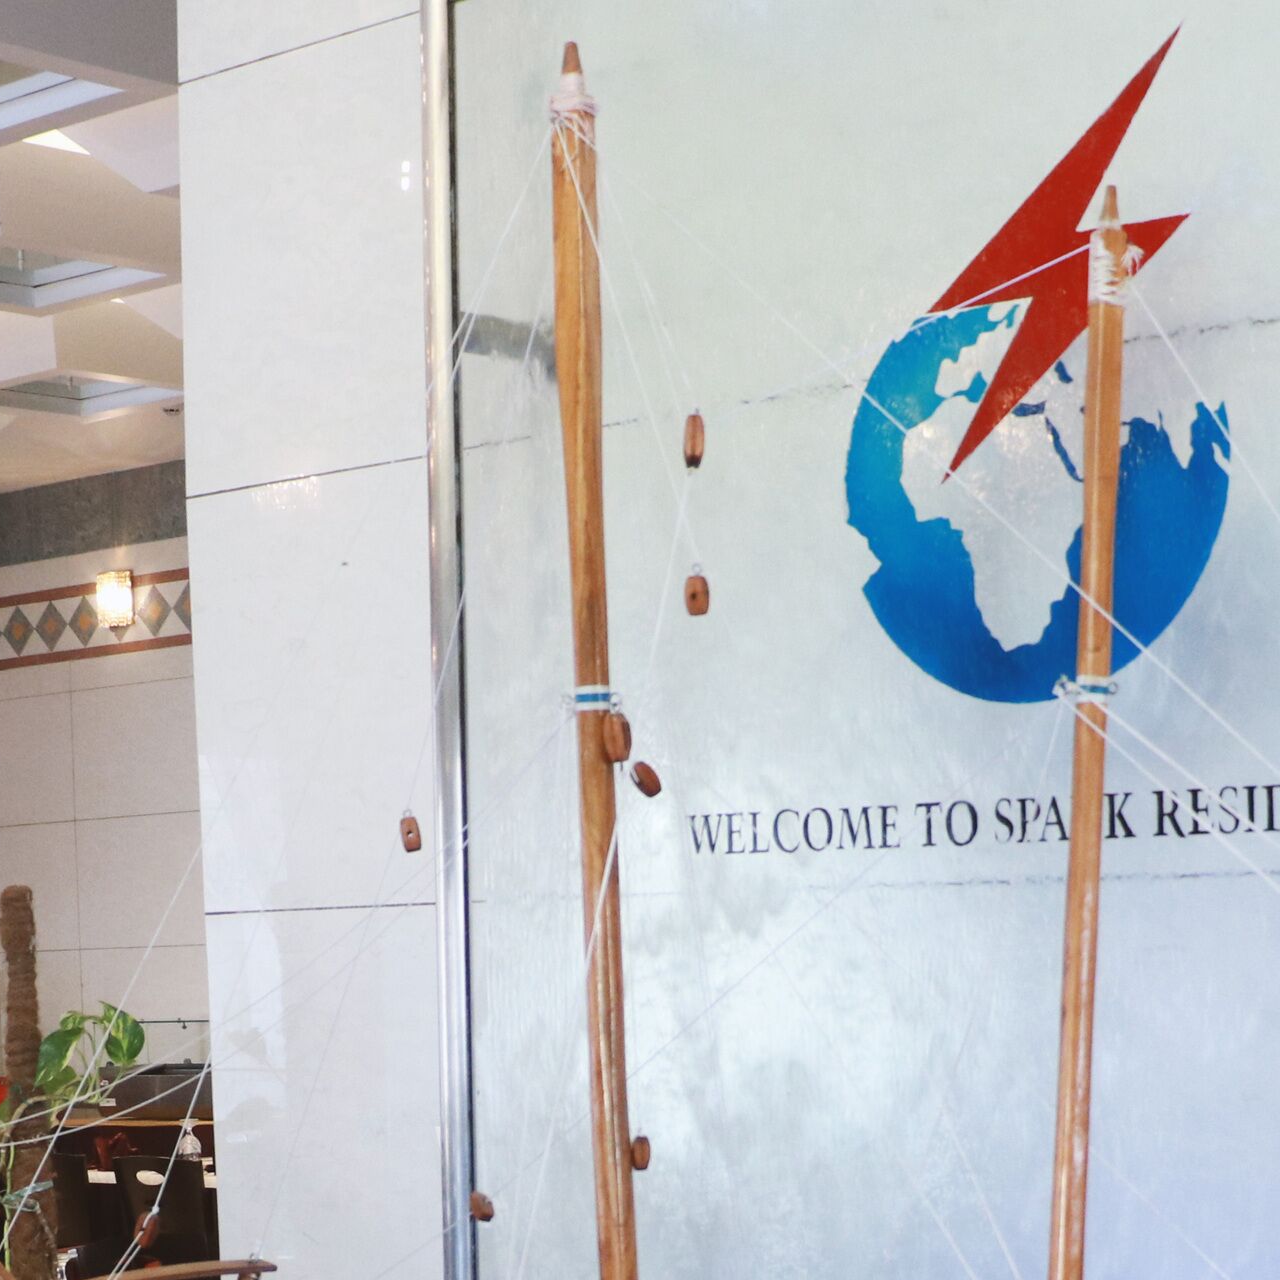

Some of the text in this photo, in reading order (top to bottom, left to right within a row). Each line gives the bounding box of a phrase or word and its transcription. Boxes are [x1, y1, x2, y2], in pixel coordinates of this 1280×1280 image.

[687, 804, 902, 855] WELCOME
[914, 800, 979, 847] TO
[994, 792, 1137, 844] SPAK
